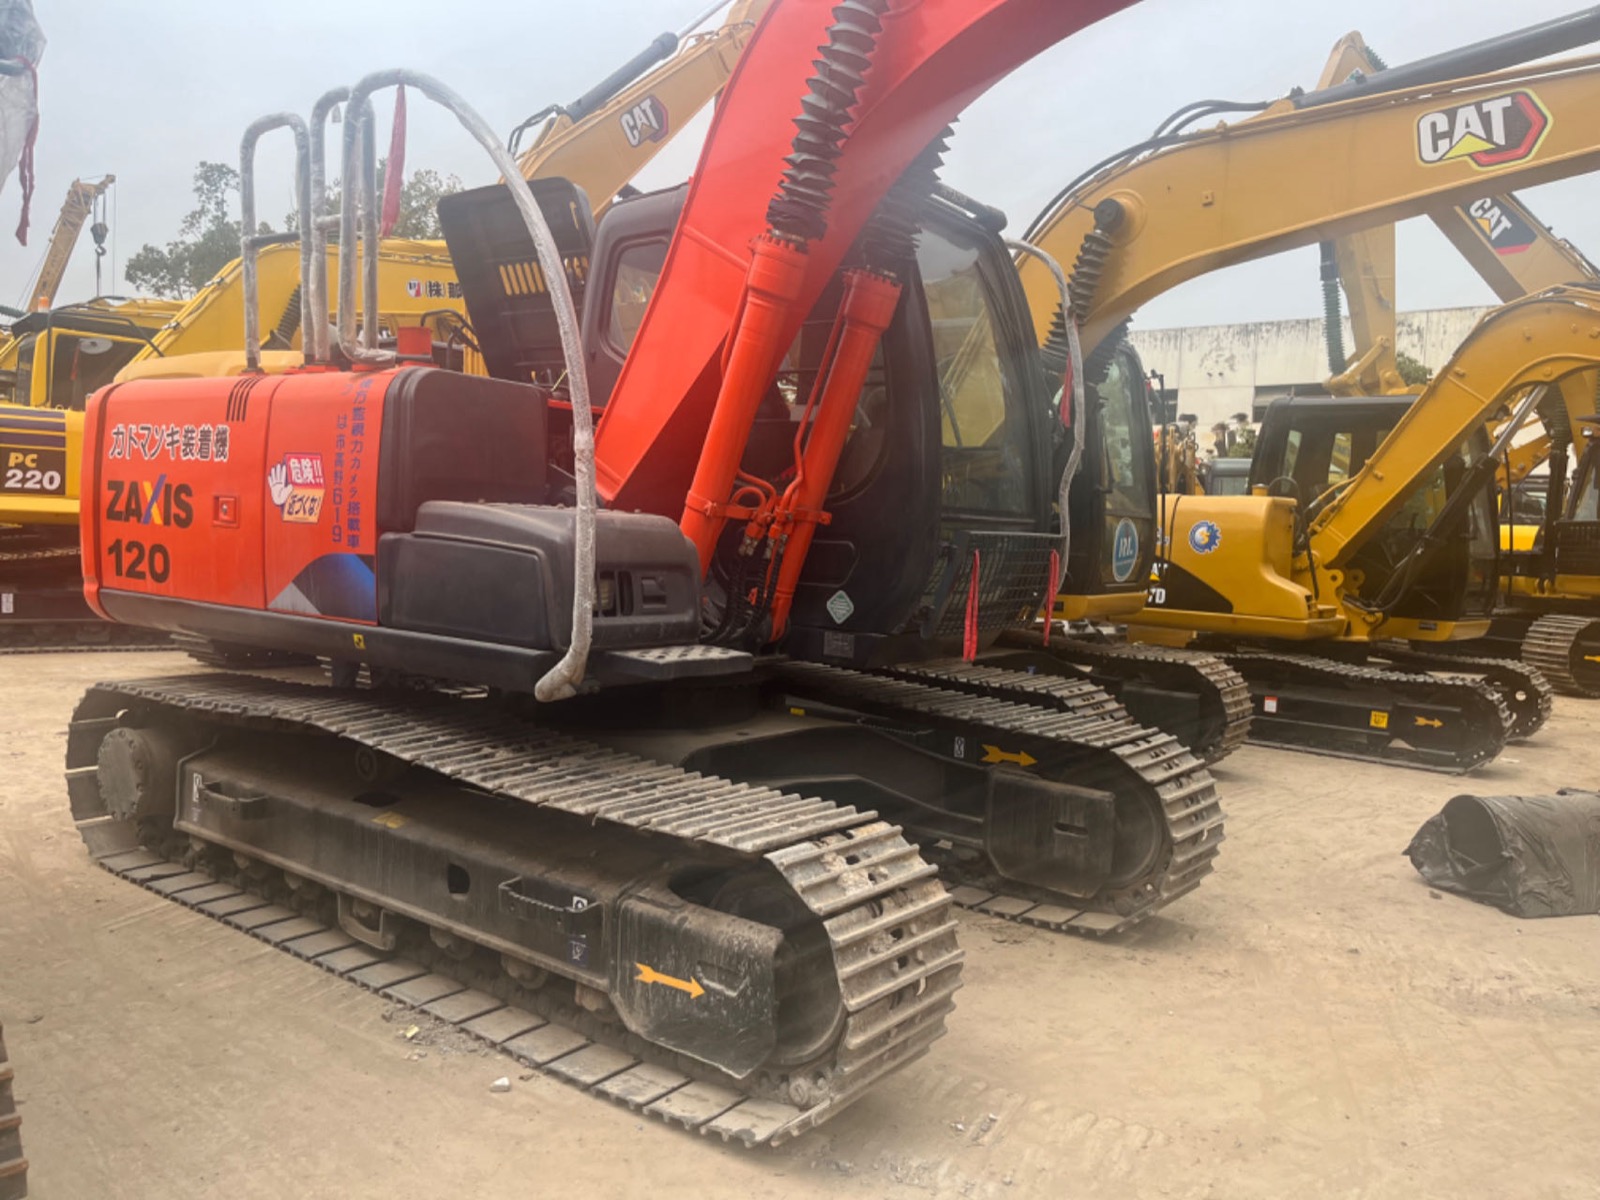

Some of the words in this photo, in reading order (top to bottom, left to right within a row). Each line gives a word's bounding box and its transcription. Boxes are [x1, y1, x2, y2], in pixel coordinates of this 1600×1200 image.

[621, 98, 660, 146] CAT
[1419, 97, 1512, 162] CAT
[1469, 197, 1513, 240] CAT
[4, 469, 61, 490] 220
[8, 452, 38, 468] PC
[106, 474, 194, 529] ZAXIS
[107, 538, 171, 584] 120
